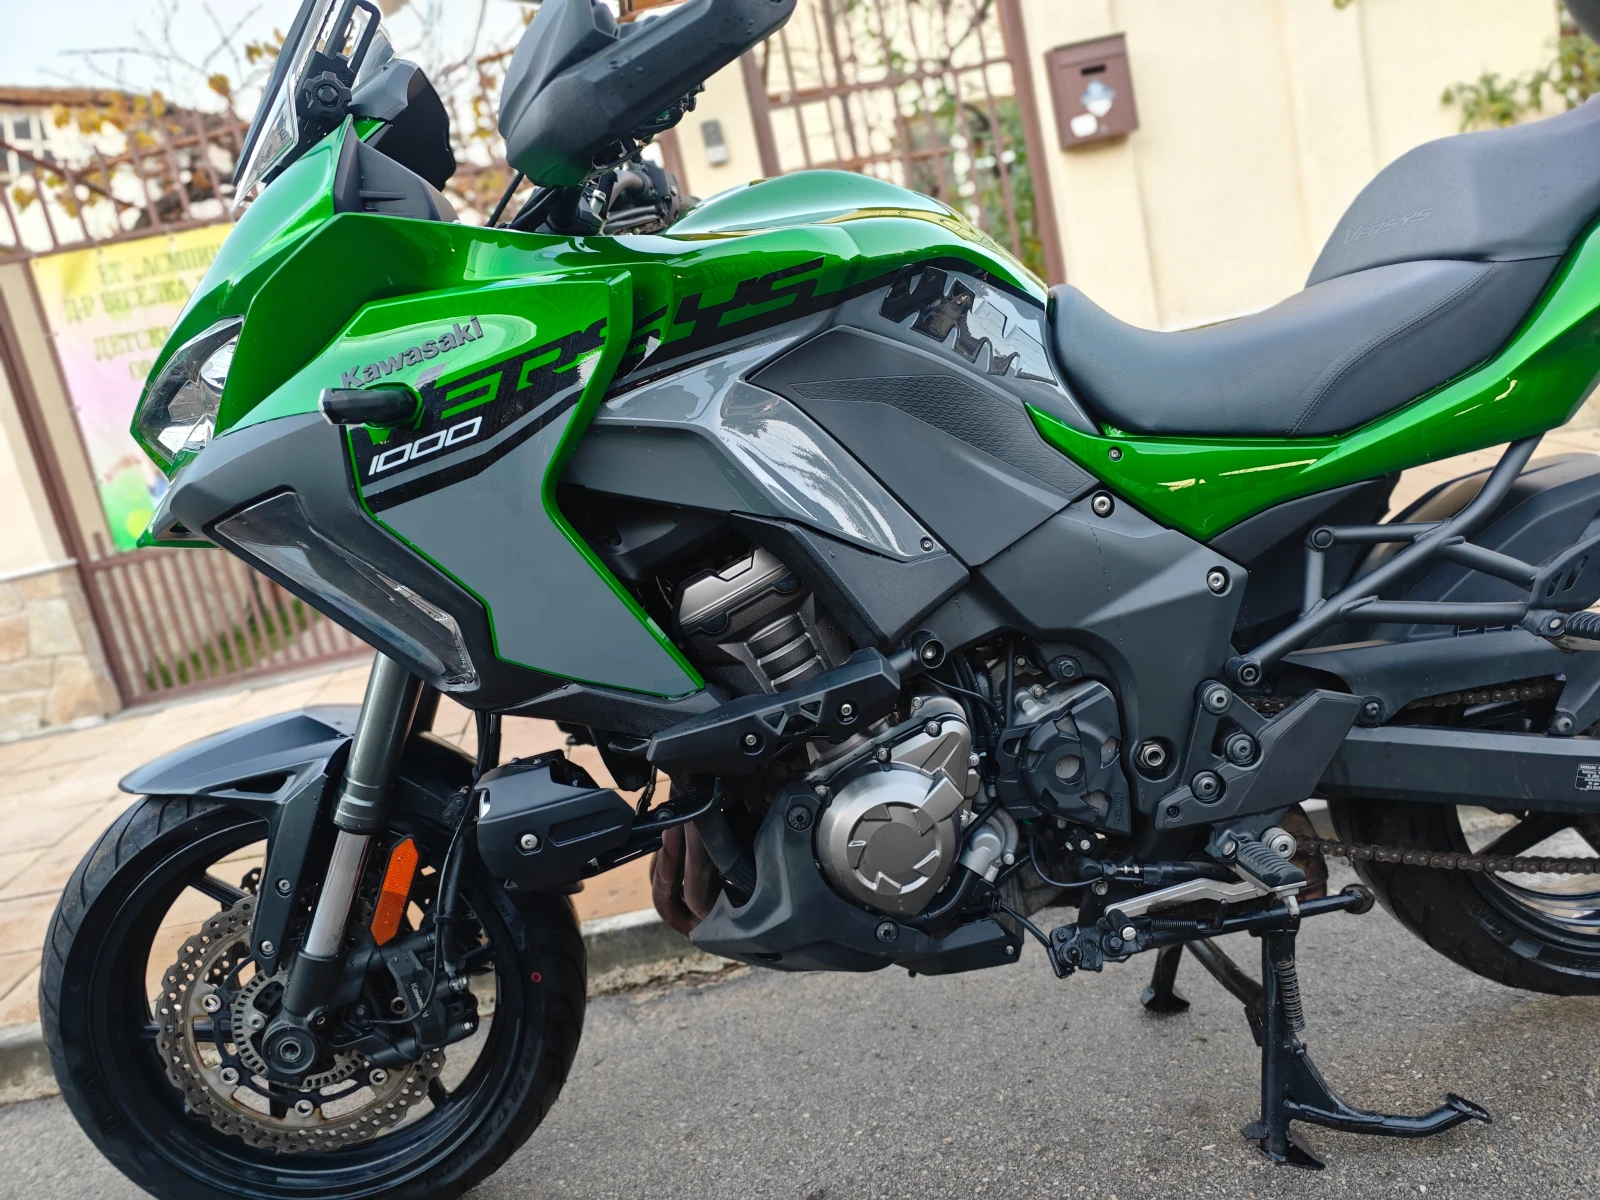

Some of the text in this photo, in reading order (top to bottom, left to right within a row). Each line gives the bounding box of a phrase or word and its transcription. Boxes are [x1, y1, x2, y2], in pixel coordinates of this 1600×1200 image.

[1343, 206, 1436, 245] VERSYS
[340, 315, 484, 388] Kawasaki
[368, 416, 483, 476] 1000
[410, 983, 430, 1018] Kawasi
